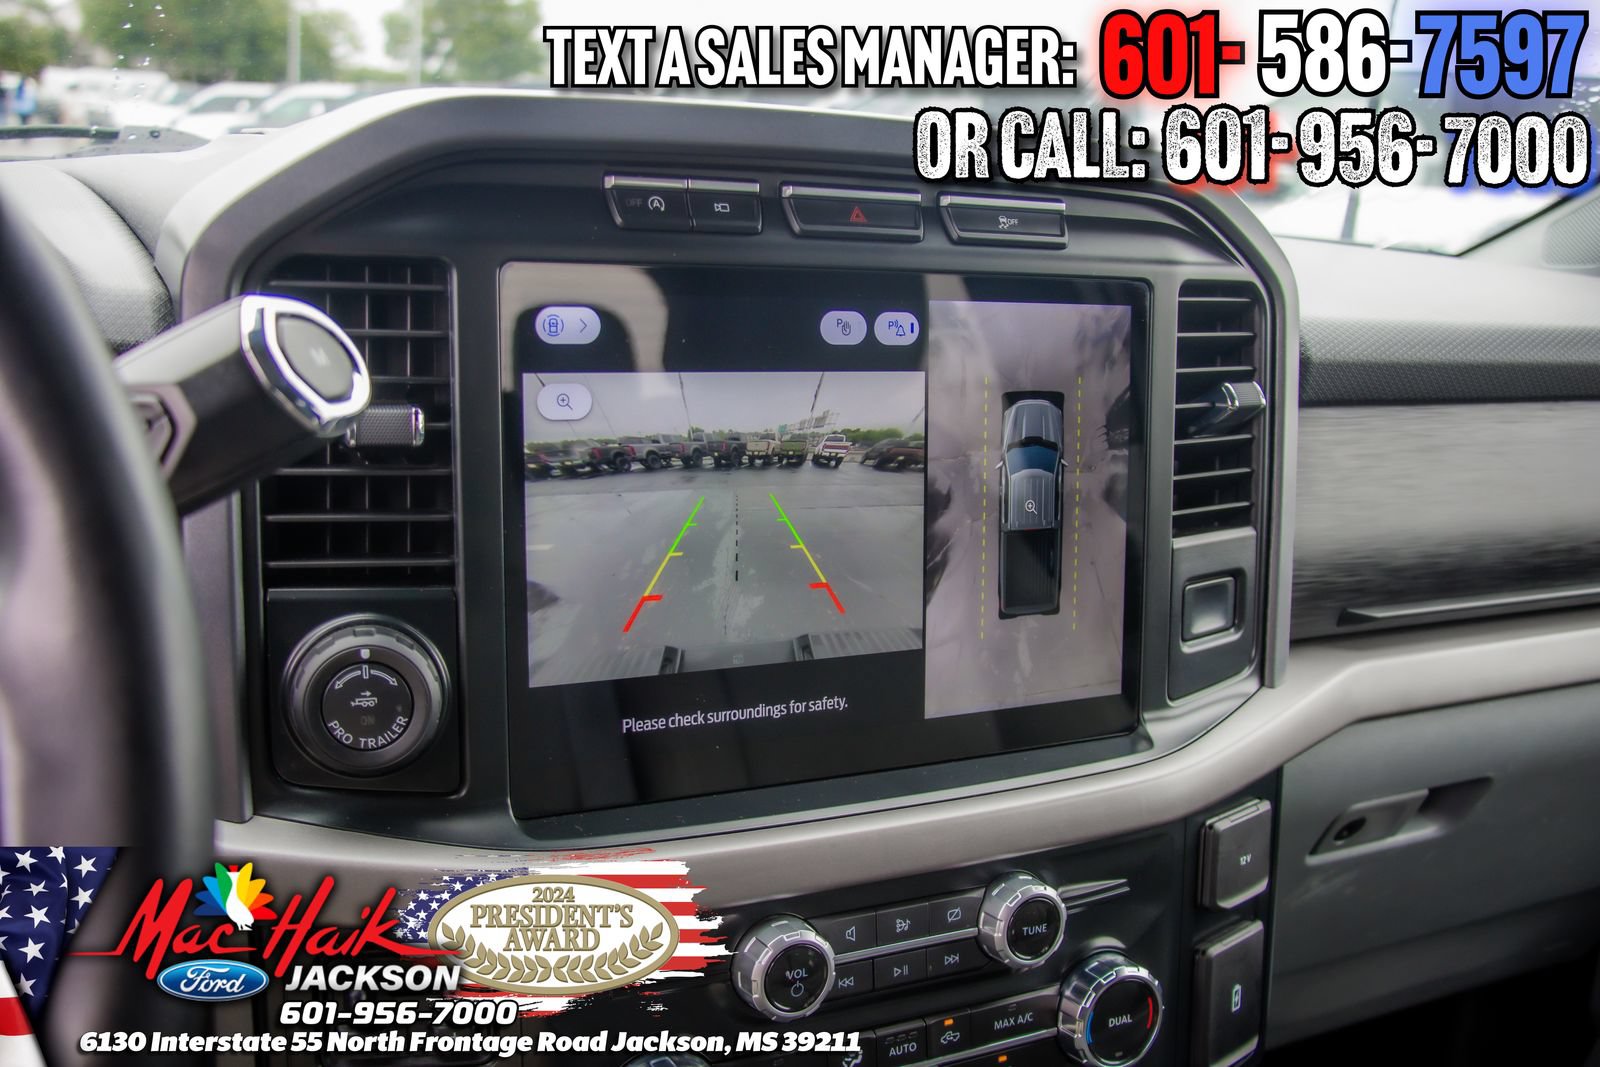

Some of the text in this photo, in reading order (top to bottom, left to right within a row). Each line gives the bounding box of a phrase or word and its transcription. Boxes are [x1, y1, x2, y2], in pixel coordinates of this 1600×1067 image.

[622, 695, 848, 733] Please check surroundings for safety.
[328, 714, 409, 750] PRO TRAILER
[1021, 922, 1049, 936] TUNE
[785, 967, 809, 980] VOL
[993, 1011, 1034, 1031] MAX A/C
[1108, 1013, 1133, 1028] DUAL
[889, 1041, 917, 1057] AUTO
